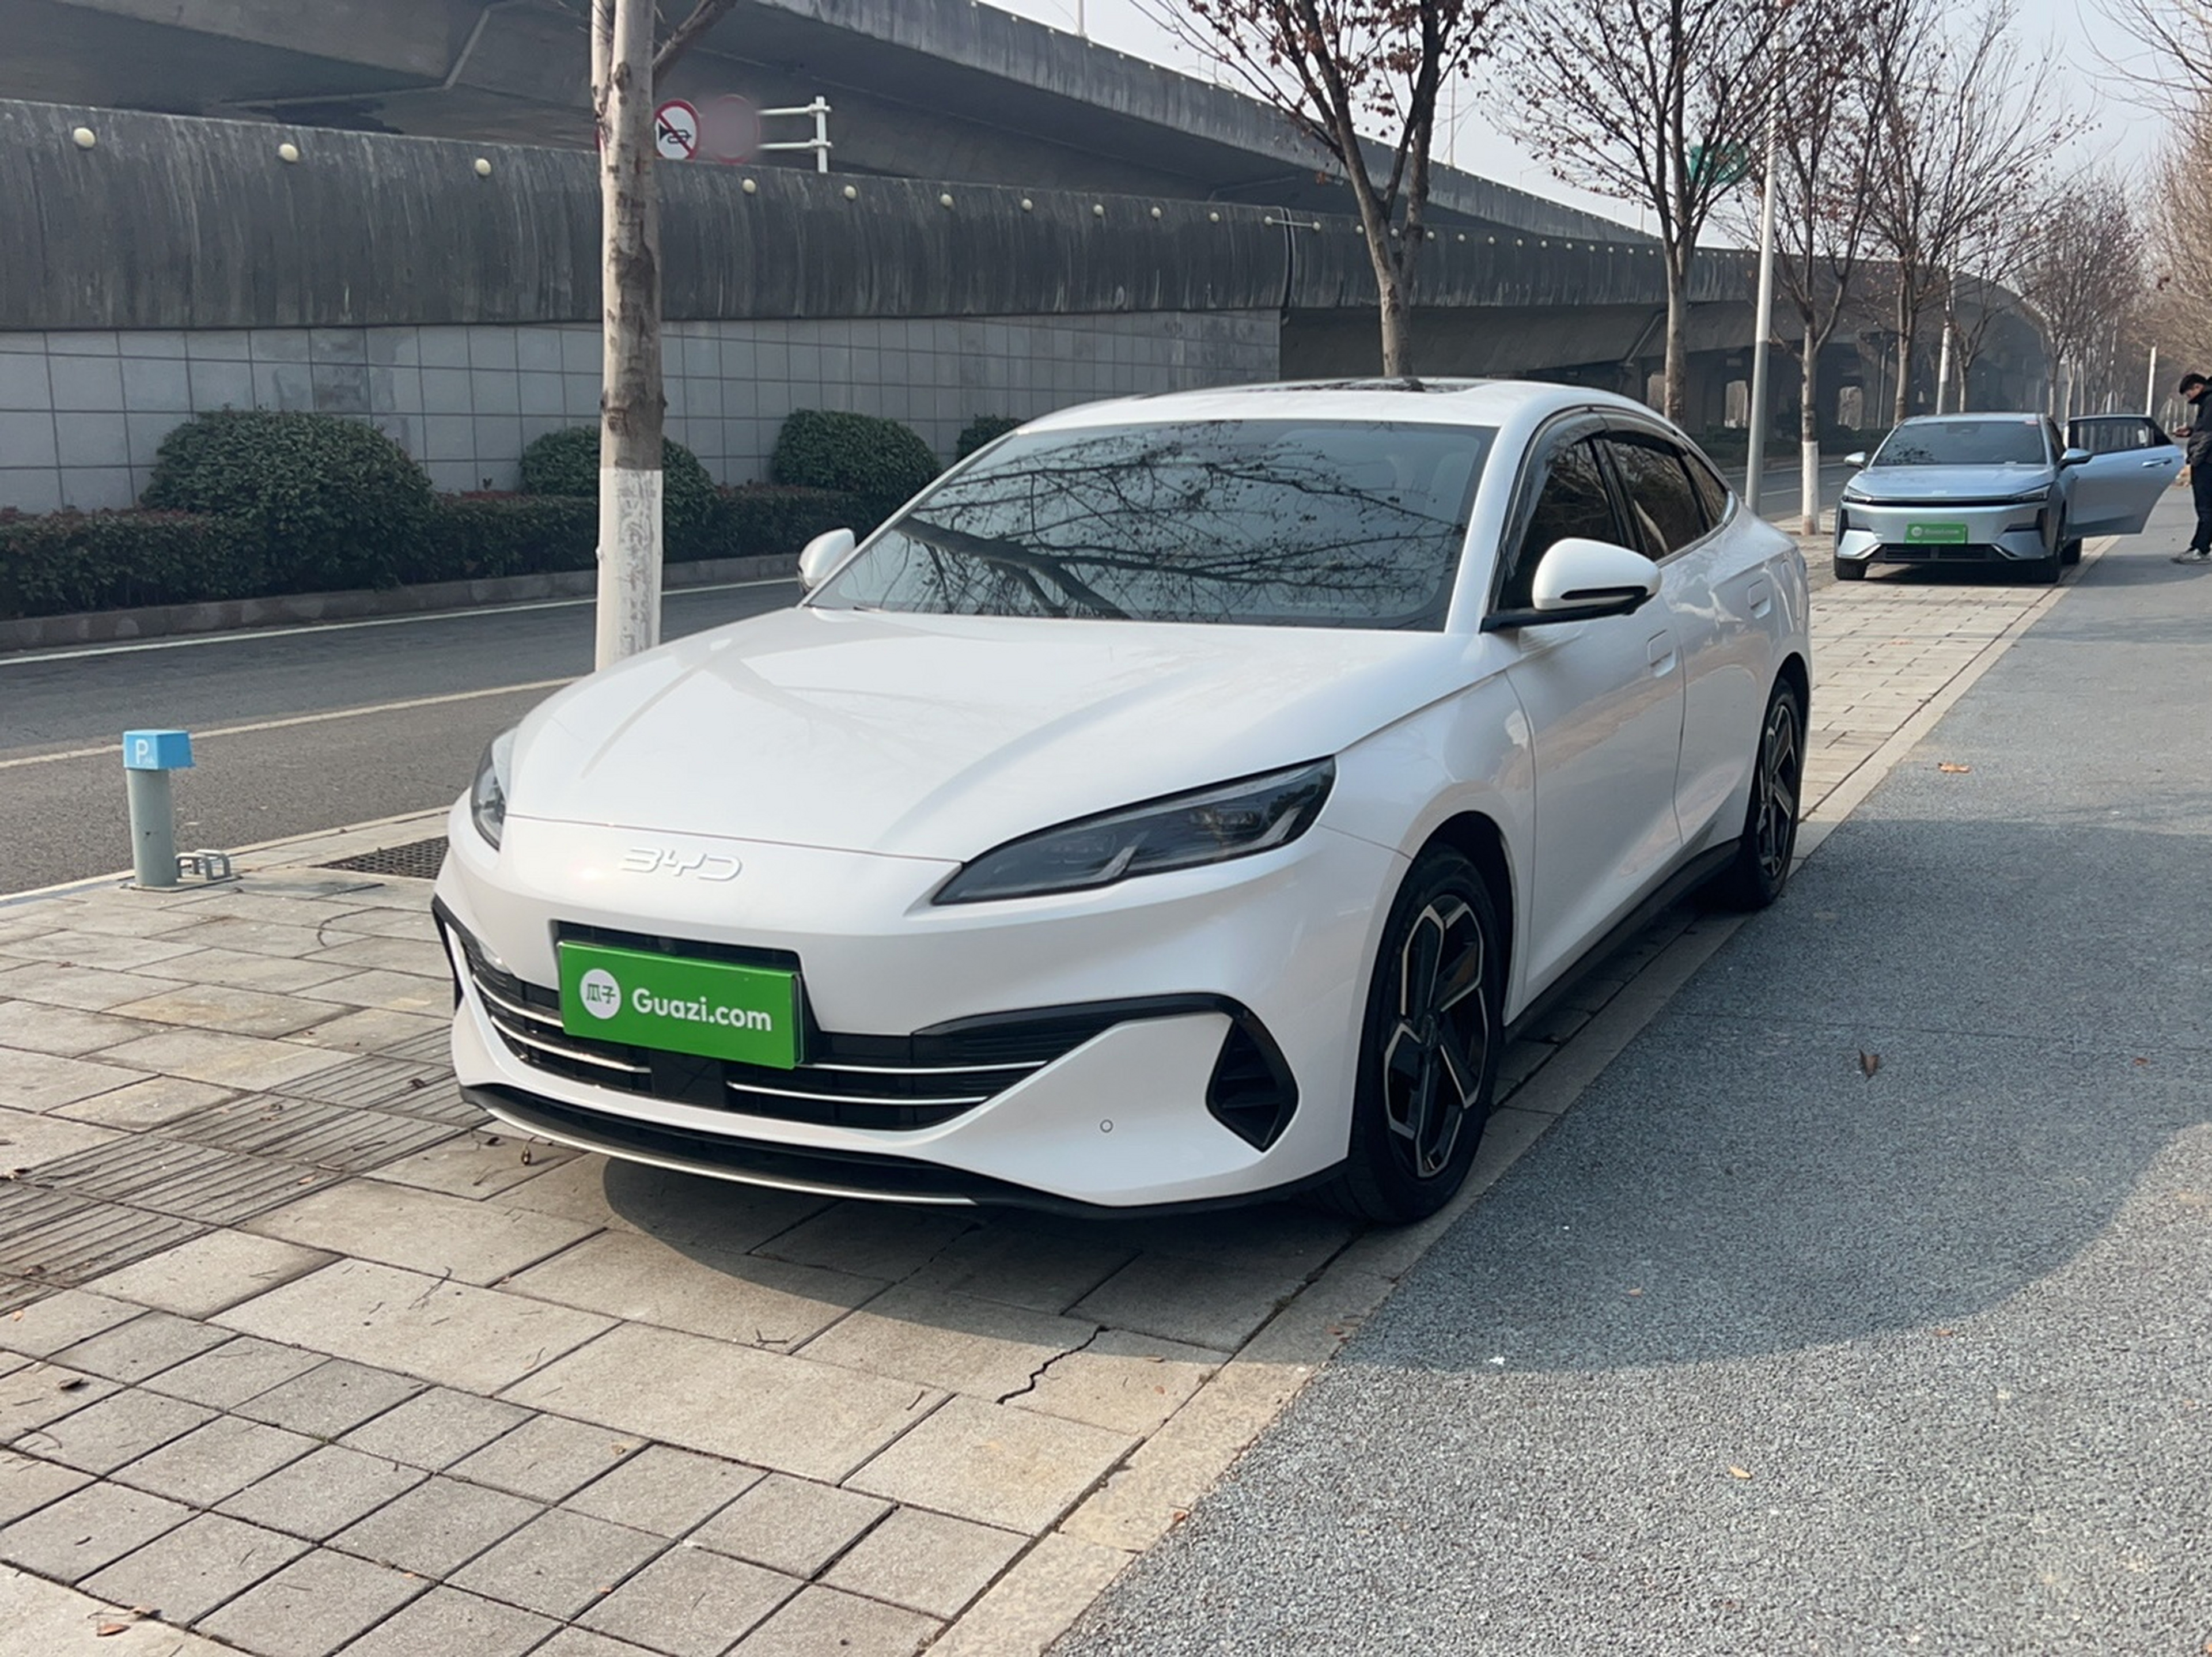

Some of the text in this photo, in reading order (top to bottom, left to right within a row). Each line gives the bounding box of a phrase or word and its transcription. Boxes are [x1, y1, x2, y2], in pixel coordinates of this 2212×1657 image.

[135, 739, 149, 765] P
[619, 846, 743, 882] BYD
[586, 983, 616, 1004] 瓜子
[632, 988, 772, 1031] Guazi.com
